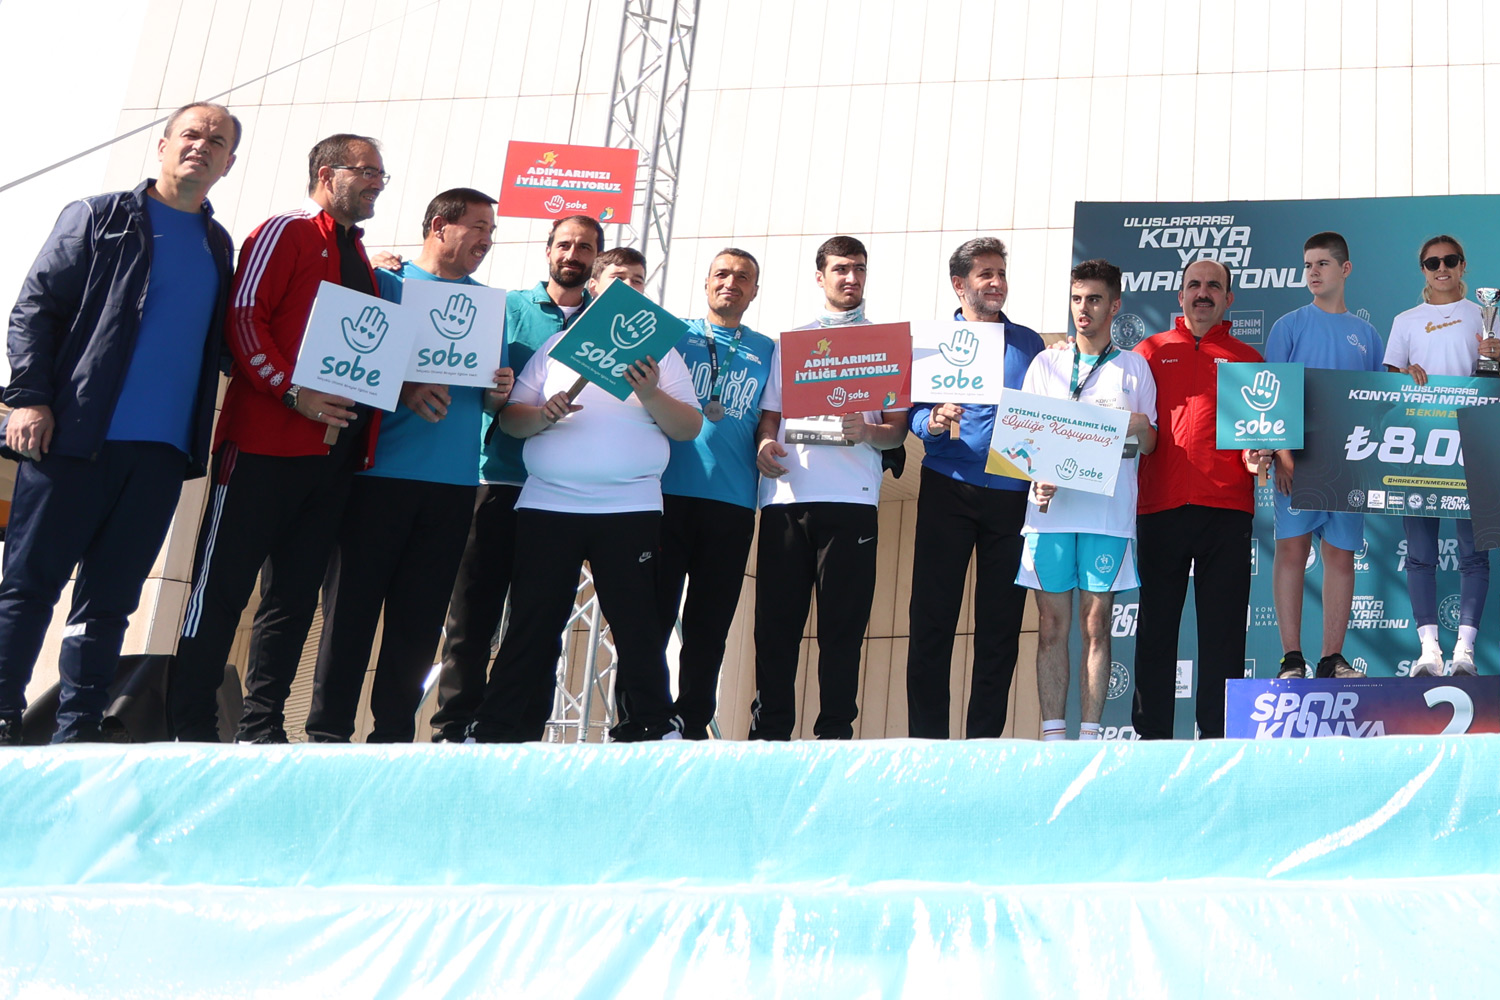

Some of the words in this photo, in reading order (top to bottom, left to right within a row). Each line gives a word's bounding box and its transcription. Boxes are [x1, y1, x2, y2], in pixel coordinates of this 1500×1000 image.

[527, 167, 611, 180] ADIMLARIMIZI
[560, 180, 621, 191] ATIYORUZ
[565, 200, 588, 210] sobe
[1124, 215, 1235, 227] ULUSLARARASI
[1139, 226, 1251, 248] KONYA
[417, 342, 478, 369] sobe
[575, 341, 628, 377] sobe
[804, 353, 887, 368] ADIMLARIMIZI
[320, 355, 381, 386] sobe
[795, 367, 837, 381] İYİLİĞE
[840, 364, 899, 378] ATIYORUZ
[931, 369, 984, 390] sobe
[848, 389, 870, 400] sobe
[1348, 389, 1400, 402] KONYA
[1402, 392, 1438, 404] YARI
[1401, 384, 1478, 395] ULUSLARARASI
[1008, 407, 1039, 418] OTİZMLİ
[1041, 413, 1099, 430] ÇOCUKLARIMIZ
[1100, 423, 1117, 433] İÇİN
[1405, 408, 1415, 416] 15
[1416, 408, 1447, 418] EKİM
[1234, 413, 1286, 437] sobe
[1079, 467, 1103, 480] sobe
[1352, 610, 1384, 619] YARI
[1250, 692, 1359, 722] SPOR
[1423, 685, 1475, 736] 2
